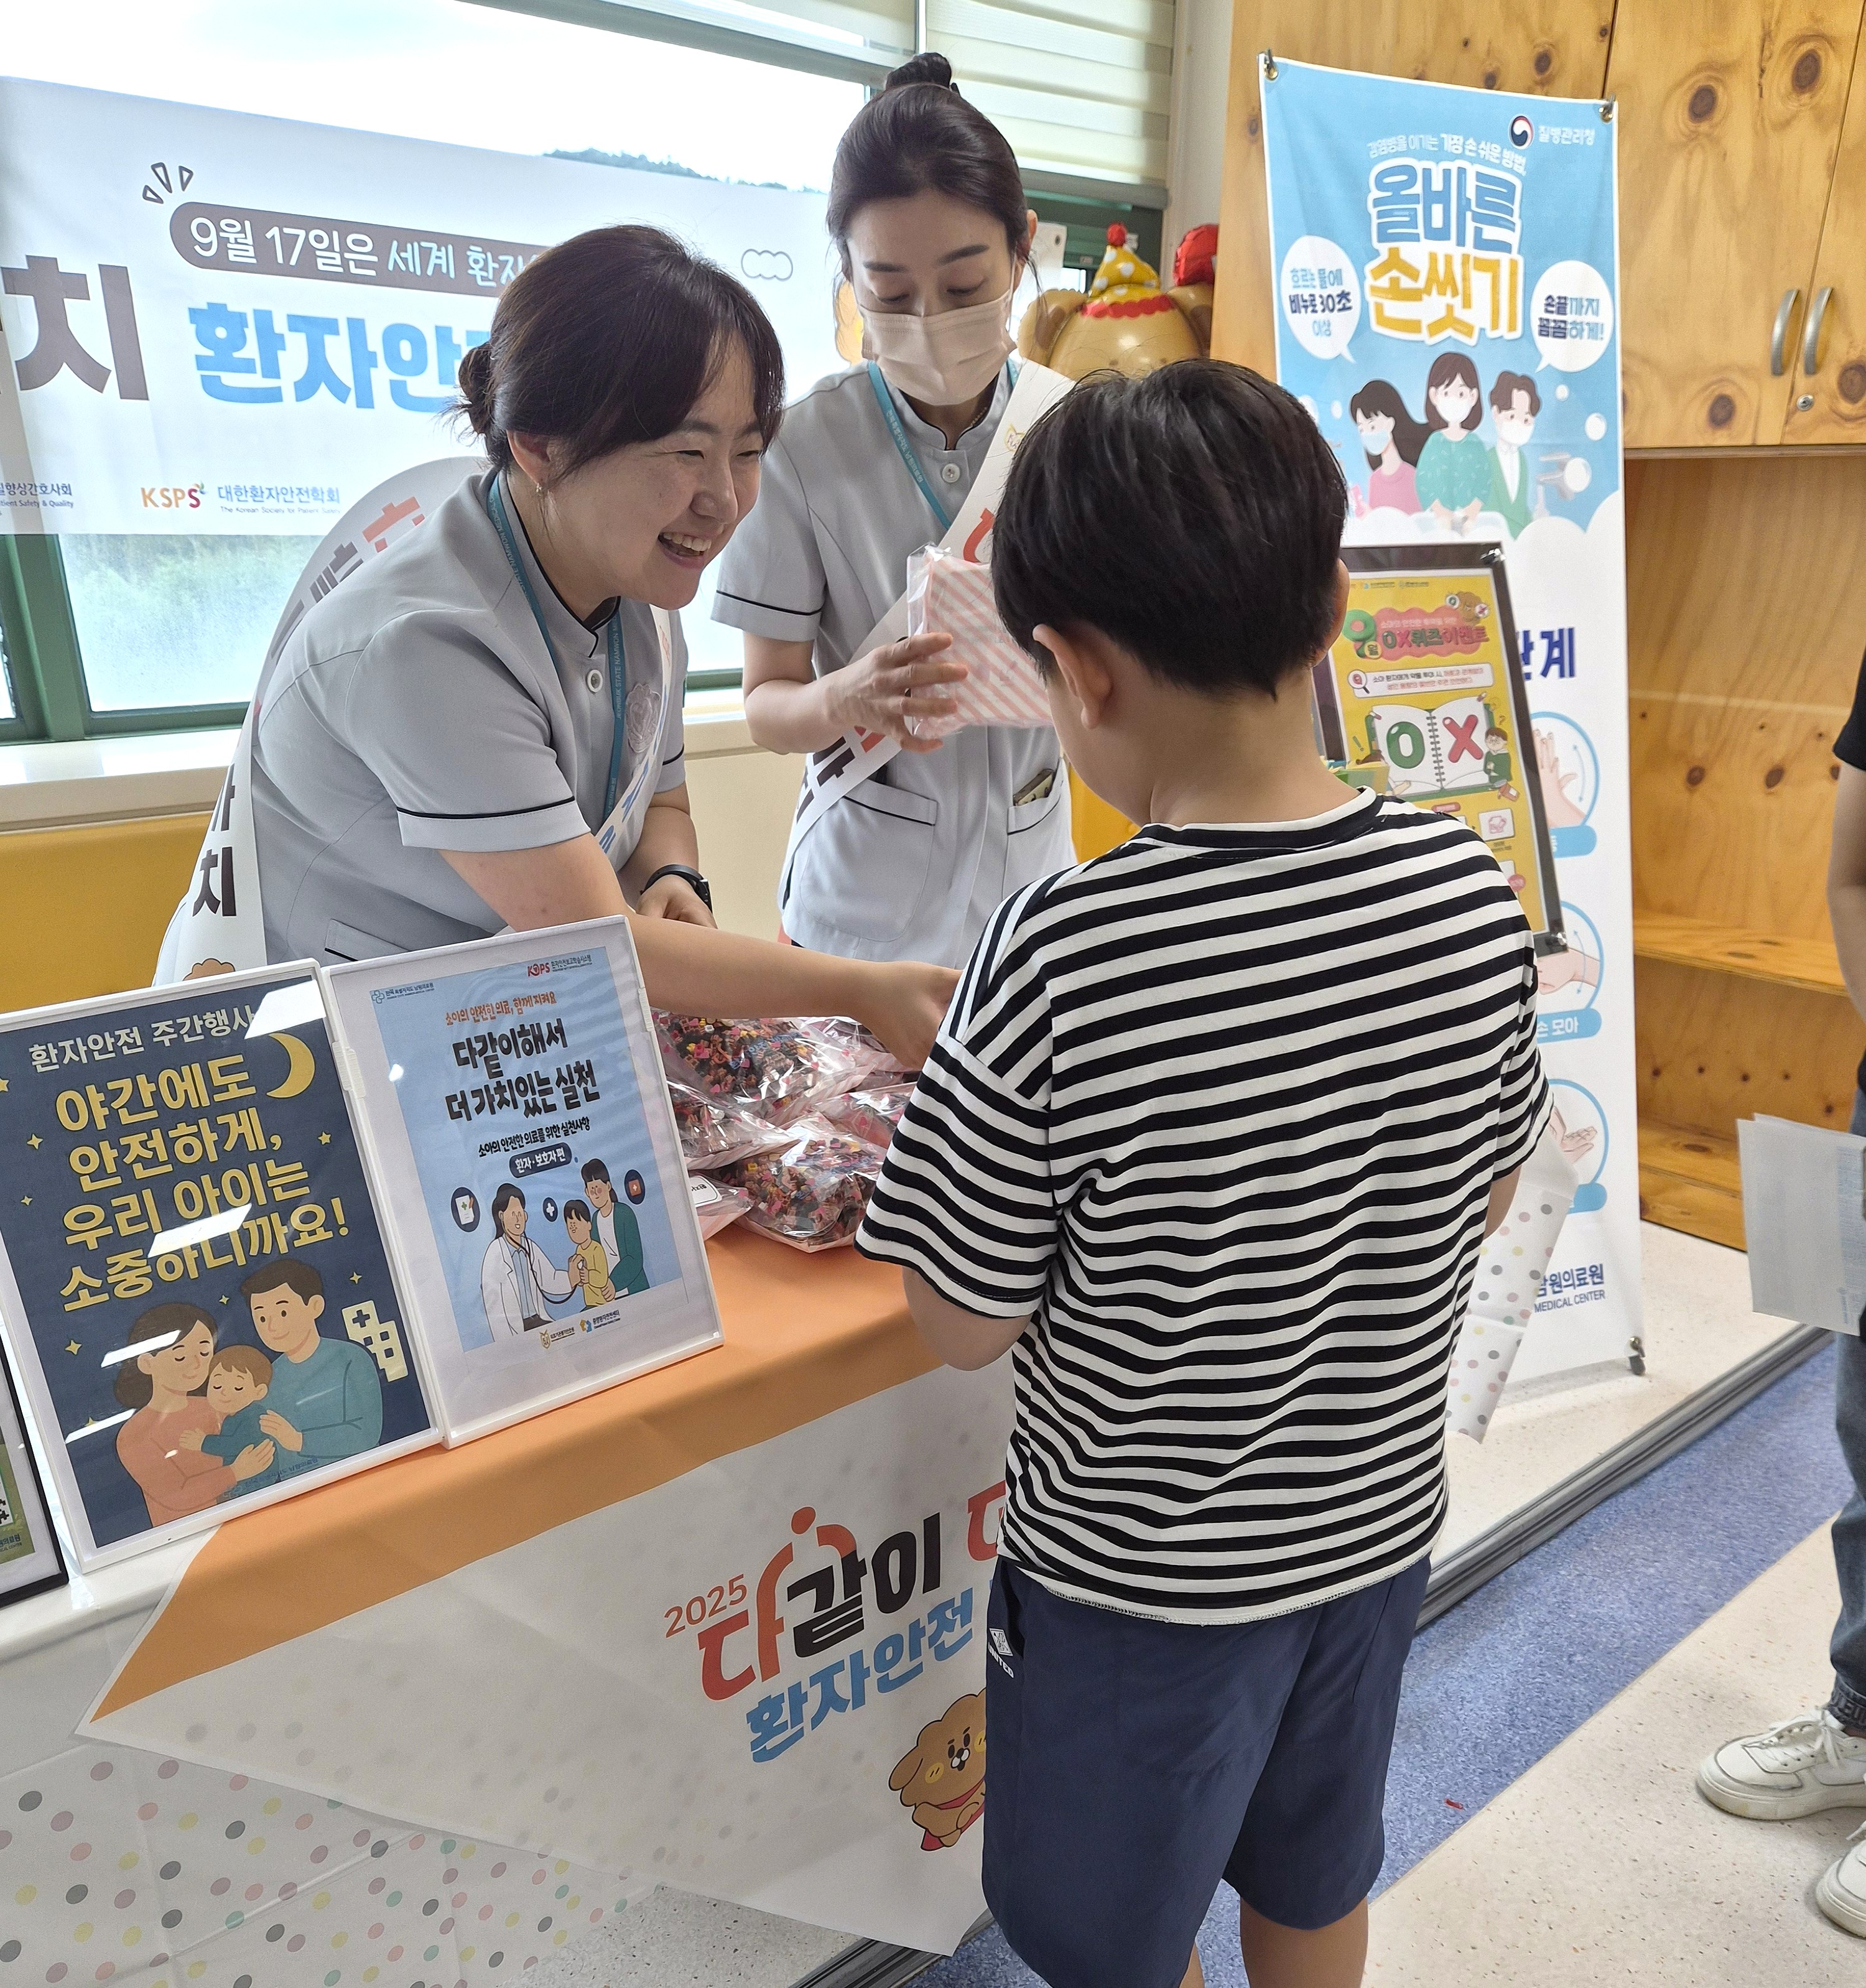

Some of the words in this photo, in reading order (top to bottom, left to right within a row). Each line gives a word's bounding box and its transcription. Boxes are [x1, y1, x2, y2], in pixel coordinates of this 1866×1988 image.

[1408, 134, 1439, 151] 이기는
[1440, 133, 1464, 154] 가장
[1371, 163, 1518, 254] 올바른
[190, 216, 257, 264] 9월
[265, 226, 378, 276] 17일은
[388, 239, 455, 279] 세계
[466, 245, 539, 287] 환자
[1289, 294, 1318, 314] 비누로
[1319, 289, 1353, 313] 30초
[1291, 268, 1316, 289] 흐르는
[1318, 269, 1343, 289] 물에
[1370, 247, 1518, 339] 손씻기
[0, 254, 150, 401] 치
[1312, 320, 1331, 337] 이상
[1538, 317, 1603, 340] 꼼꼼하게!
[1544, 295, 1600, 317] 손끝까지
[188, 302, 490, 414] 환자안
[49, 500, 74, 508] Quality
[141, 487, 202, 509] KSPS
[218, 485, 340, 504] 대한환자안전학회
[1442, 714, 1483, 763] X
[445, 1008, 470, 1026] 소아의
[470, 1003, 496, 1023] 안전한
[495, 1000, 514, 1015] 의료,
[513, 995, 534, 1015] 함께
[1553, 1016, 1579, 1036] 모아
[29, 1028, 146, 1073] 환자안전
[151, 1005, 255, 1047] 주간행사
[452, 1018, 568, 1080] 다같이해서
[56, 1054, 256, 1132] 야간에도
[555, 1059, 600, 1110] 실천
[70, 1107, 282, 1192] 안전하게,
[478, 1140, 501, 1158] 소아의
[501, 1133, 524, 1152] 안전한
[524, 1128, 546, 1145] 의료를
[545, 1124, 561, 1139] 위한
[561, 1117, 590, 1136] 실천사항
[556, 1147, 566, 1162] 편
[63, 1188, 163, 1251] 우리
[174, 1159, 312, 1221] 아이는
[1534, 1297, 1572, 1312] MEDICAL
[1574, 1289, 1605, 1304] CENTER
[664, 1573, 747, 1638] 2025
[697, 1506, 942, 1701] 다같이
[746, 1587, 973, 1763] 환자안전
